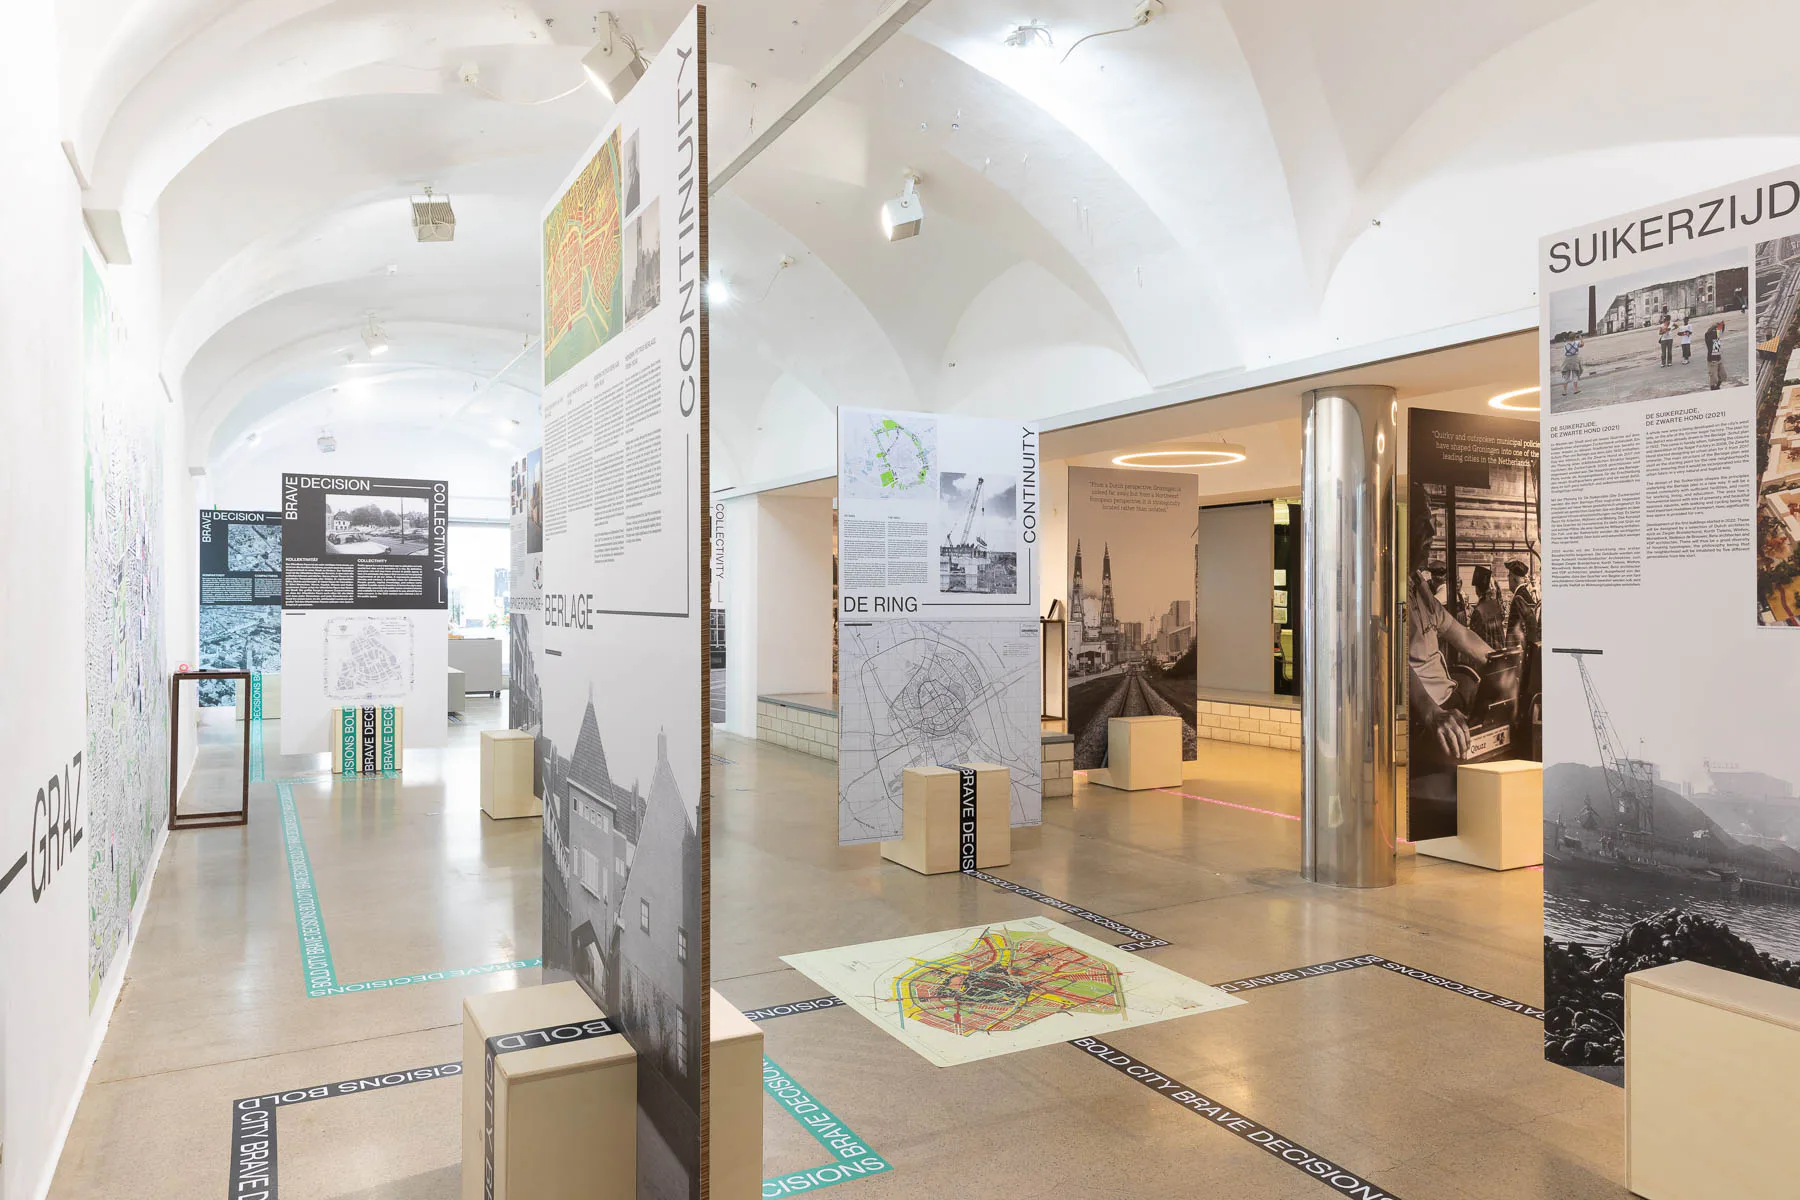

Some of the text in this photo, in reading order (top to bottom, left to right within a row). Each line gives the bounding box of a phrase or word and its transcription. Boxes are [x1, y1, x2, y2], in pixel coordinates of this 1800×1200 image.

[677, 47, 695, 417] CONTINUITY
[1548, 180, 1800, 274] SUIKERZIJD
[1559, 430, 1583, 438] ZWARTE
[1656, 417, 1683, 426] ZWARTE
[1684, 414, 1704, 422] HOND
[1436, 442, 1450, 450] have
[1451, 444, 1471, 452] shaped
[1472, 445, 1500, 456] Groningen
[1530, 450, 1540, 458] the
[1442, 452, 1463, 463] leading
[1464, 454, 1480, 462] cities
[1488, 456, 1497, 464] the
[286, 476, 370, 520] BRAVE DECISION
[1022, 426, 1036, 544] CONTINUITY
[202, 512, 264, 543] BRAVE DECISION
[434, 484, 446, 574] COLLECTIVITY
[716, 504, 724, 579] COLLECTIVITY
[545, 594, 594, 630] BERLAGE
[844, 596, 918, 612] DE RING
[364, 737, 374, 772] BRAVE
[384, 736, 393, 770] BRAVE
[31, 751, 83, 904] GRAZ
[962, 769, 974, 870] BRAVE DECIS
[449, 960, 526, 976] BRAVE
[1236, 972, 1300, 988] BRAVE
[1298, 964, 1337, 978] CITY
[1383, 962, 1494, 1000] DECISIONS
[496, 1020, 611, 1049] BOLD
[238, 1086, 328, 1110] BOLD
[240, 1110, 269, 1138] CITY
[804, 1112, 866, 1158] BRAVE
[1074, 1037, 1394, 1200] BOLD CITY BRAVE DECISION
[238, 1140, 269, 1192] BRAVE
